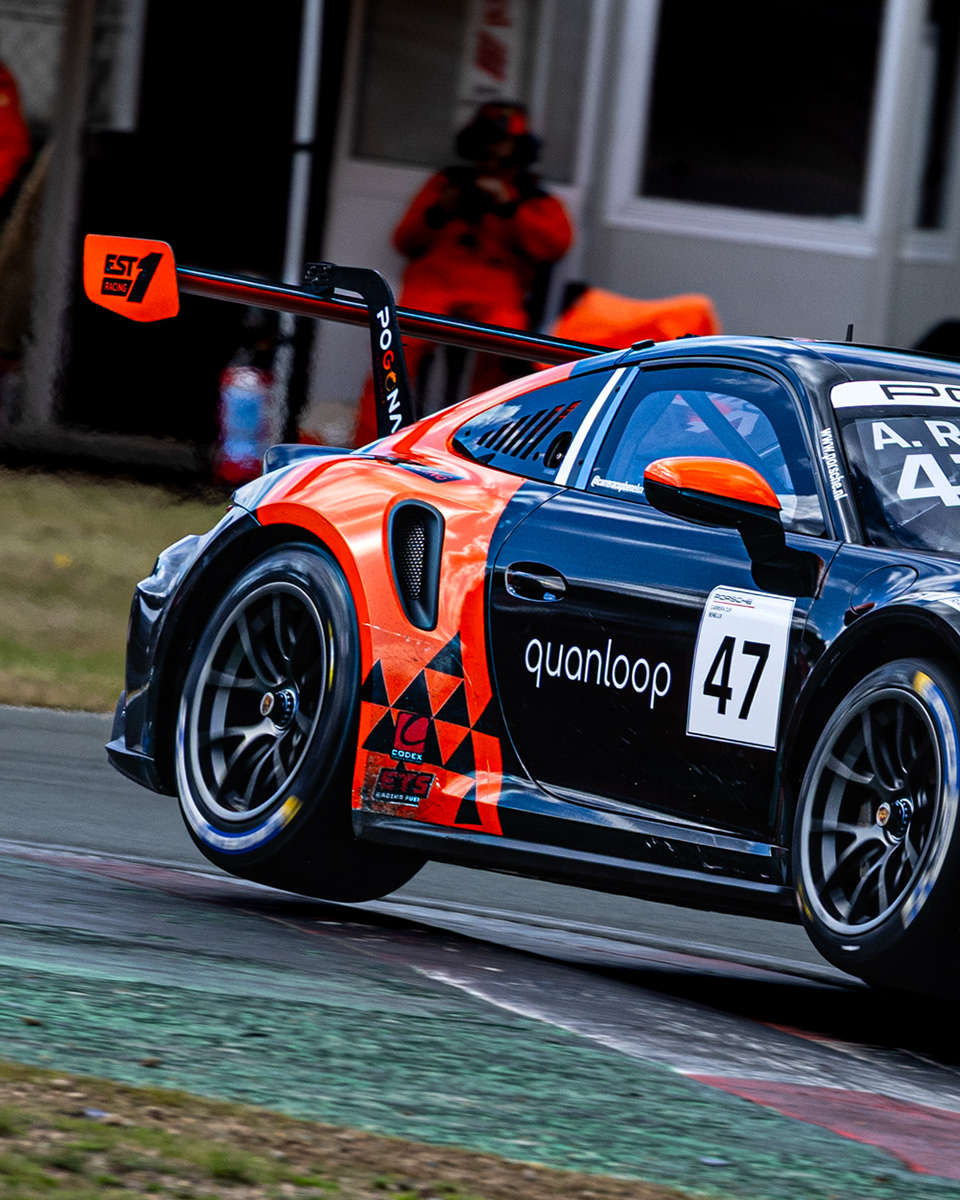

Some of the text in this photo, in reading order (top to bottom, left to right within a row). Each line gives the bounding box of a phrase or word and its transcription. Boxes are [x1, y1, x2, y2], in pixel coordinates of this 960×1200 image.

[104, 282, 127, 293] RACING
[872, 421, 924, 450] A.
[821, 427, 848, 500] www.porsche.nl
[525, 638, 672, 710] quanloop
[703, 635, 771, 720] 47
[391, 749, 423, 761] CODEX
[375, 792, 404, 800] RACING
[380, 770, 431, 795] ETS
